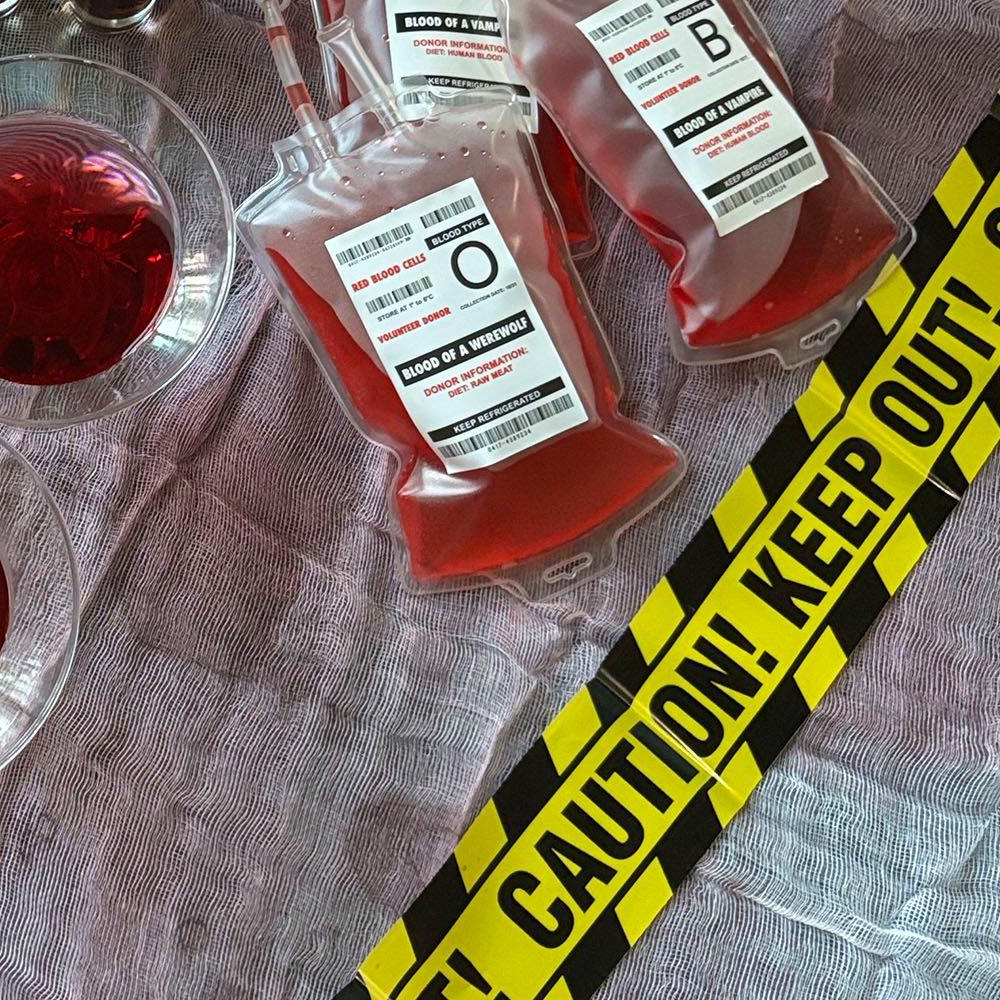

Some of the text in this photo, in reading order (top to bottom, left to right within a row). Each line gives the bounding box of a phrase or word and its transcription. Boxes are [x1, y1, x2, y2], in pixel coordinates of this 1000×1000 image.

[405, 17, 500, 32] BLOOD OF A VAMP
[669, 6, 693, 24] BLOOD
[448, 50, 475, 58] HUMAN
[477, 53, 502, 61] BLOOD
[450, 40, 509, 53] INFORMATION
[608, 51, 625, 64] RED
[625, 37, 651, 56] BLOOD
[649, 27, 670, 43] CELLS
[687, 18, 732, 63] B
[429, 77, 449, 86] KEEP
[640, 73, 701, 110] VOLUNTEER DONOR
[673, 84, 765, 139] BLOOD OF A VAMPIRE
[692, 108, 772, 156] DONOR INFORMATION:
[707, 121, 770, 159] DIET: HUMAN BLOOD
[723, 147, 789, 188] KEEP REFRIGERATED
[431, 217, 484, 246] BLOOD TYPE
[351, 253, 427, 292] RED BLOOD CELLS
[451, 240, 498, 289] O
[377, 309, 399, 322] STORE
[398, 304, 408, 312] AT
[459, 293, 490, 310] COLLECTION
[377, 305, 451, 344] VOLUNTEER DONOR
[401, 316, 529, 380] BLOOD OF A WEREWOLF
[423, 345, 528, 397] DONOR INFORMATION:
[447, 363, 514, 398] DIET: RAW MEAT
[453, 389, 541, 434] KEEP REFRIGERATED
[498, 276, 1000, 948] CAUTION! KEEP OUT!
